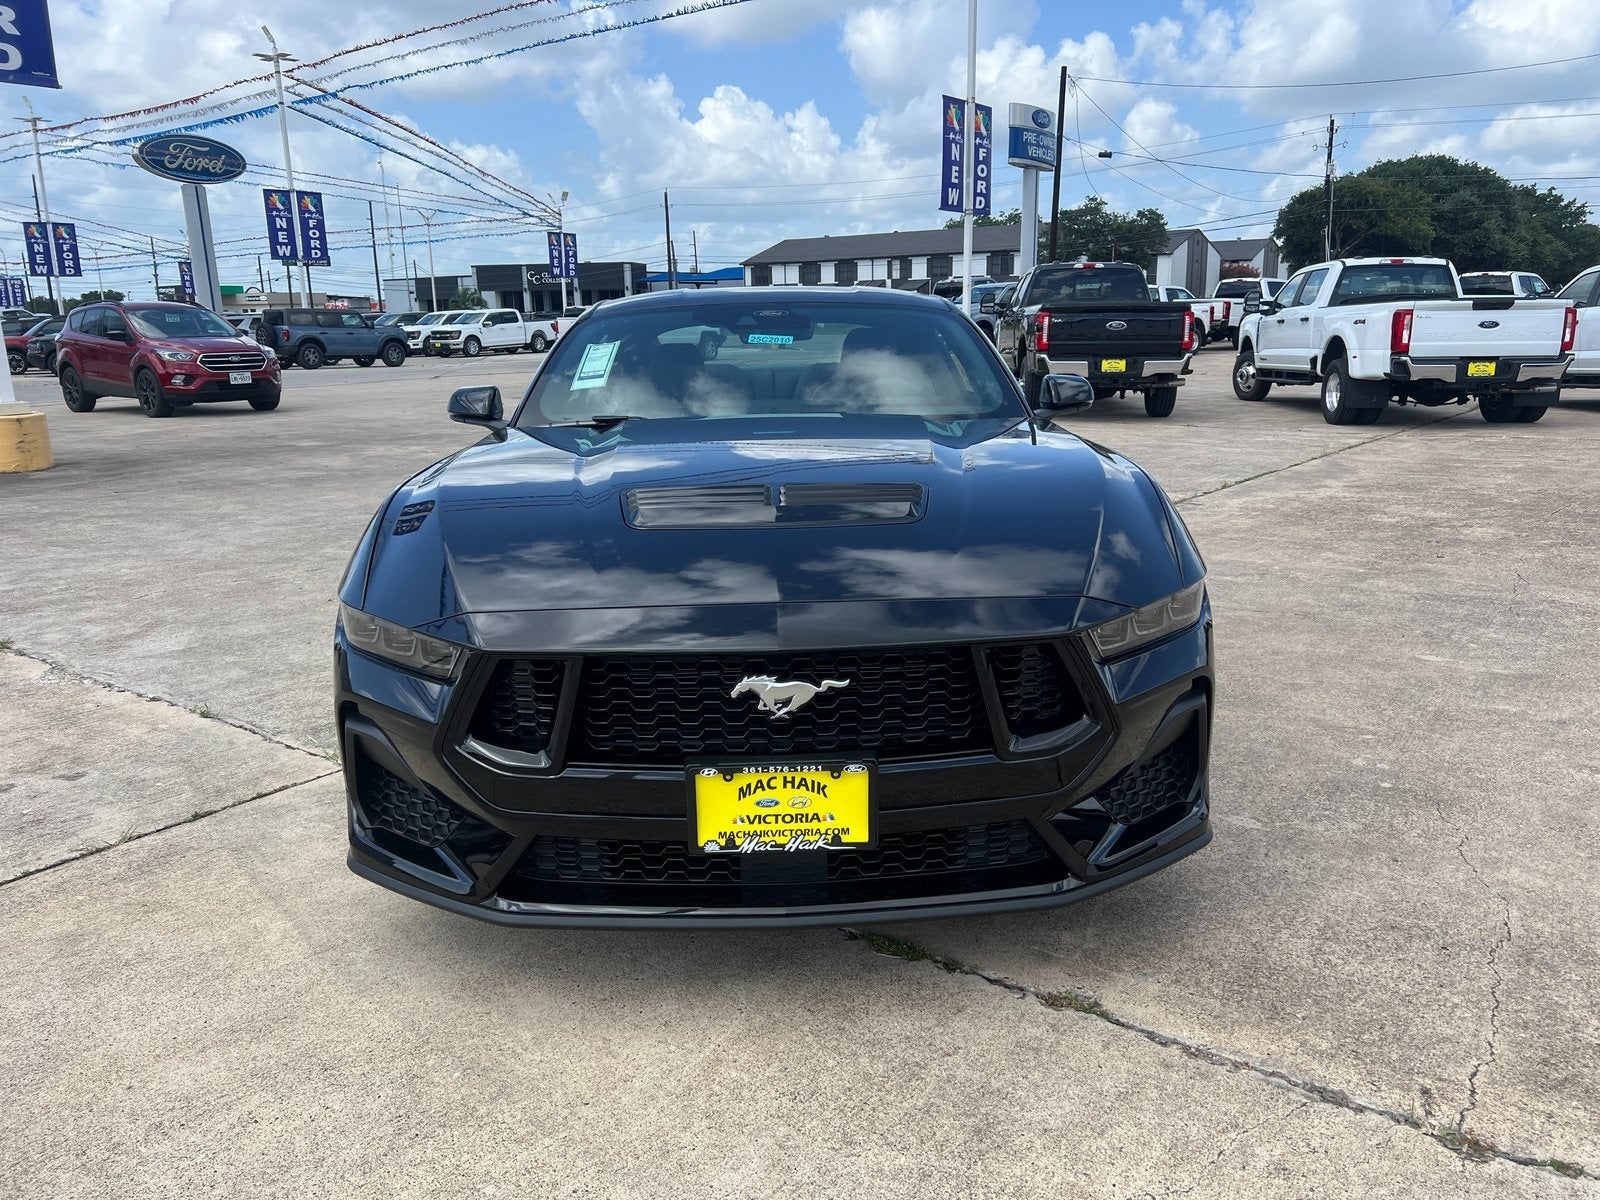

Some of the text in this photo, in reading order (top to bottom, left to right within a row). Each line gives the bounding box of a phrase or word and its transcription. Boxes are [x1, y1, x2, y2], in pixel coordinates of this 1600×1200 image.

[163, 142, 226, 173] Ford
[1027, 145, 1054, 161] VEHICLES
[948, 143, 960, 206] NEW
[975, 147, 987, 209] FORD
[275, 217, 291, 257] NEW
[308, 219, 322, 258] FORD
[33, 243, 48, 274] NEW
[62, 244, 75, 275] FORD
[552, 249, 560, 275] NEW
[568, 250, 576, 276] FORD
[184, 274, 192, 294] NEW
[742, 765, 822, 774] 361-576-1221
[738, 775, 828, 802] MAC HAIK
[758, 799, 778, 807] Ford
[745, 812, 822, 825] VICTORIA
[718, 827, 850, 839] MACHAIKVICTORIACOM
[738, 834, 830, 854] Mac Haik
